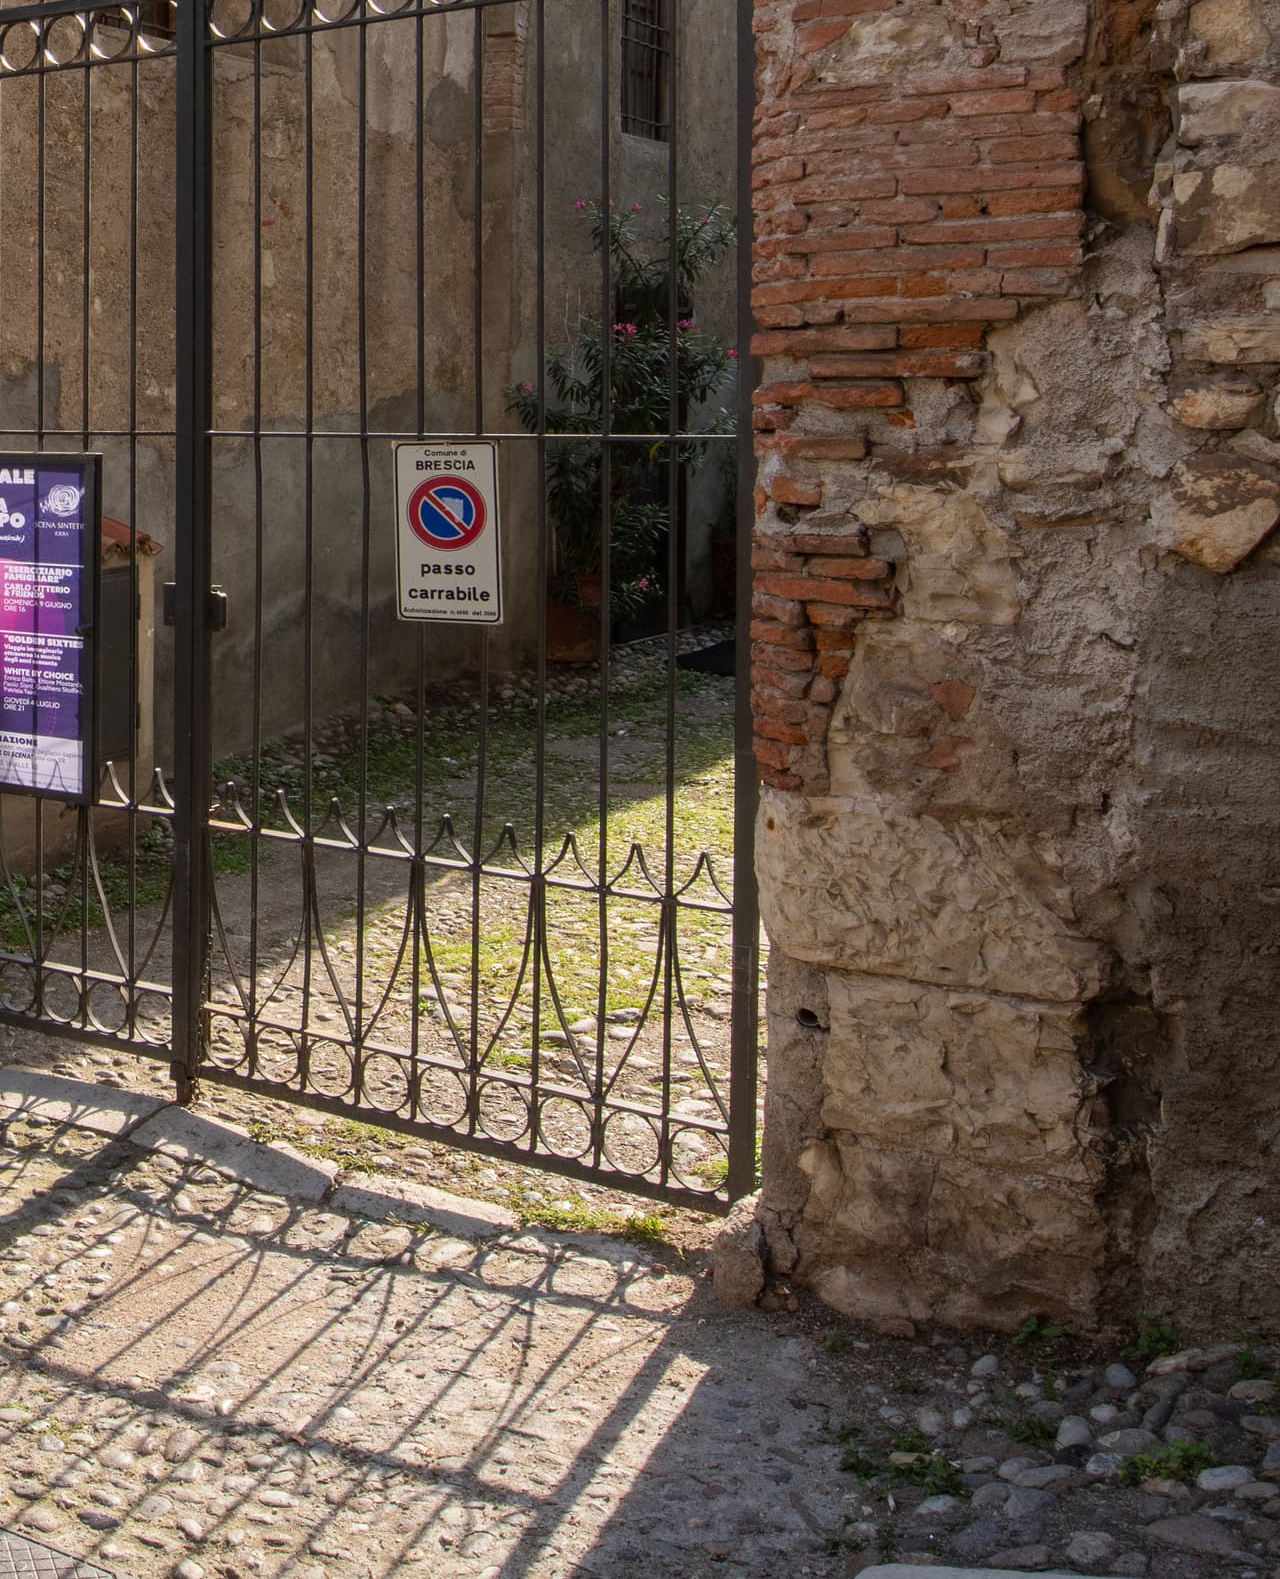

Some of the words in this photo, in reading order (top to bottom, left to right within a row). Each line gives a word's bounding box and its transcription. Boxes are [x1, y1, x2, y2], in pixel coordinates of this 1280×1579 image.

[424, 449, 458, 457] Comune
[415, 460, 476, 471] BRESCIA
[35, 521, 56, 529] SCENA
[421, 563, 476, 578] passo
[4, 582, 32, 591] CARLO
[33, 585, 71, 594] CITTERIO
[11, 590, 45, 599] FRIENDS
[408, 586, 491, 602] carrabile
[4, 598, 38, 607] DOMENICA
[45, 601, 73, 610] GIUGNO
[4, 634, 46, 646] "GOLDEN
[4, 667, 30, 677] WHITE
[43, 670, 75, 681] CHOICE
[4, 703, 17, 711] ORE
[36, 700, 60, 709] LUGLIO
